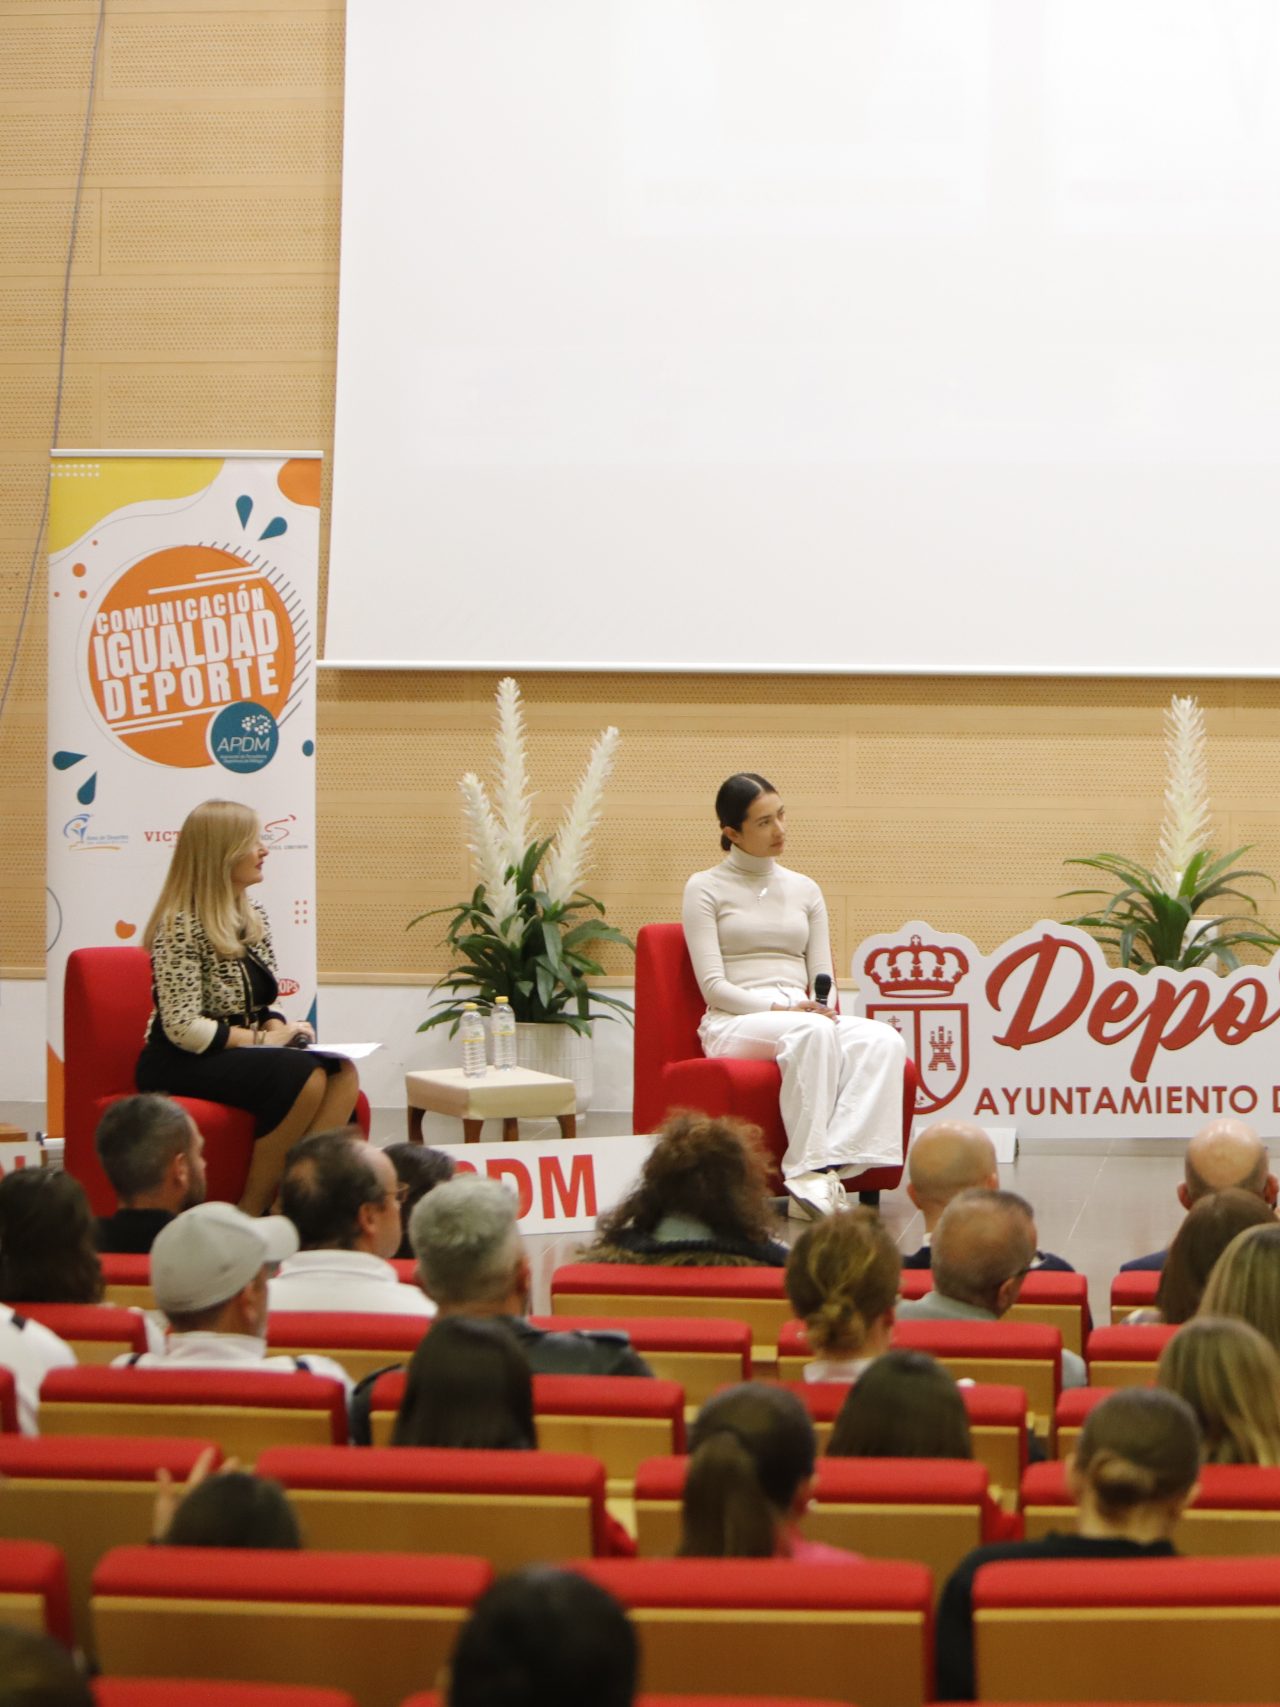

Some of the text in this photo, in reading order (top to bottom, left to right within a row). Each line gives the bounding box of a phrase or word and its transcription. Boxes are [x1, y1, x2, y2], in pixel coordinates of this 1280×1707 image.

[95, 583, 266, 636] COMUNICACIÓN
[93, 608, 280, 682] IGUALDAD
[102, 654, 280, 721] DEPORTE
[216, 736, 271, 753] APDM
[973, 1085, 1259, 1116] AYUNTAMIENTO
